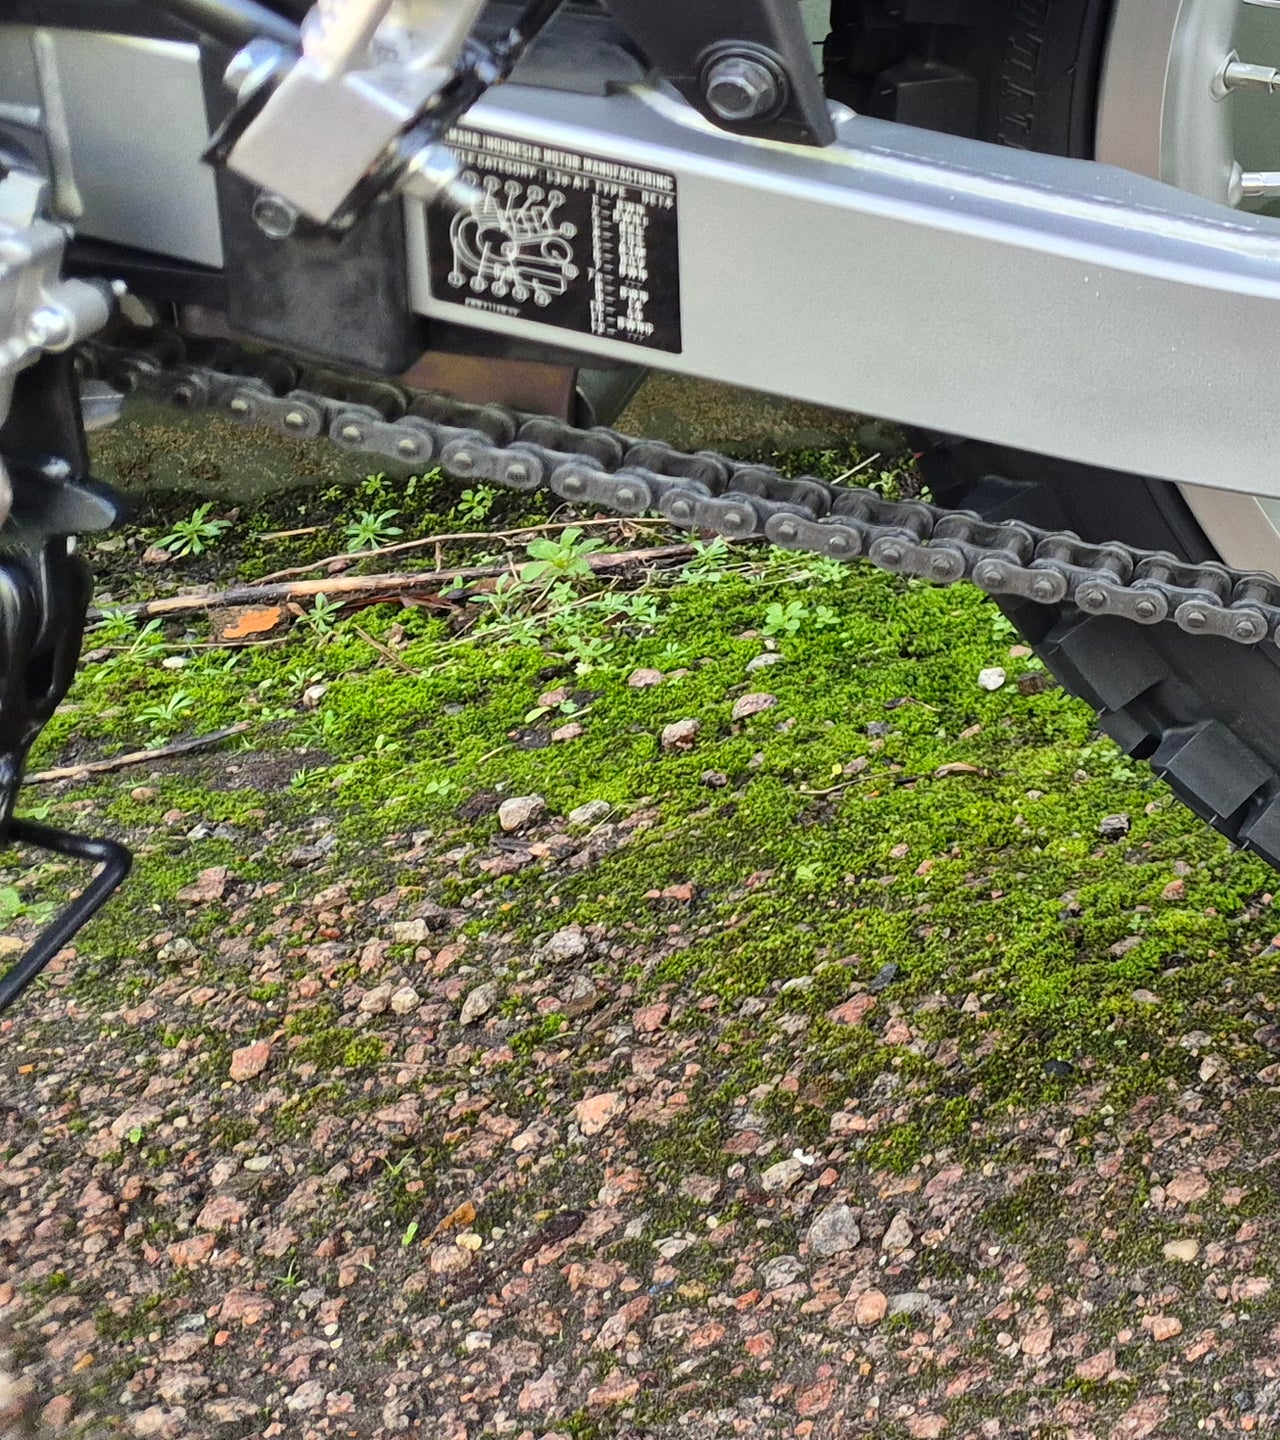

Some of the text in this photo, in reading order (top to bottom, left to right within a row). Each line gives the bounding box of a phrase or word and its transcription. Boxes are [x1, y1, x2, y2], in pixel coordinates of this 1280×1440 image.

[482, 133, 543, 161] INDONESIA
[543, 147, 583, 171] MOTOR
[583, 156, 674, 190] MANUFACTURING
